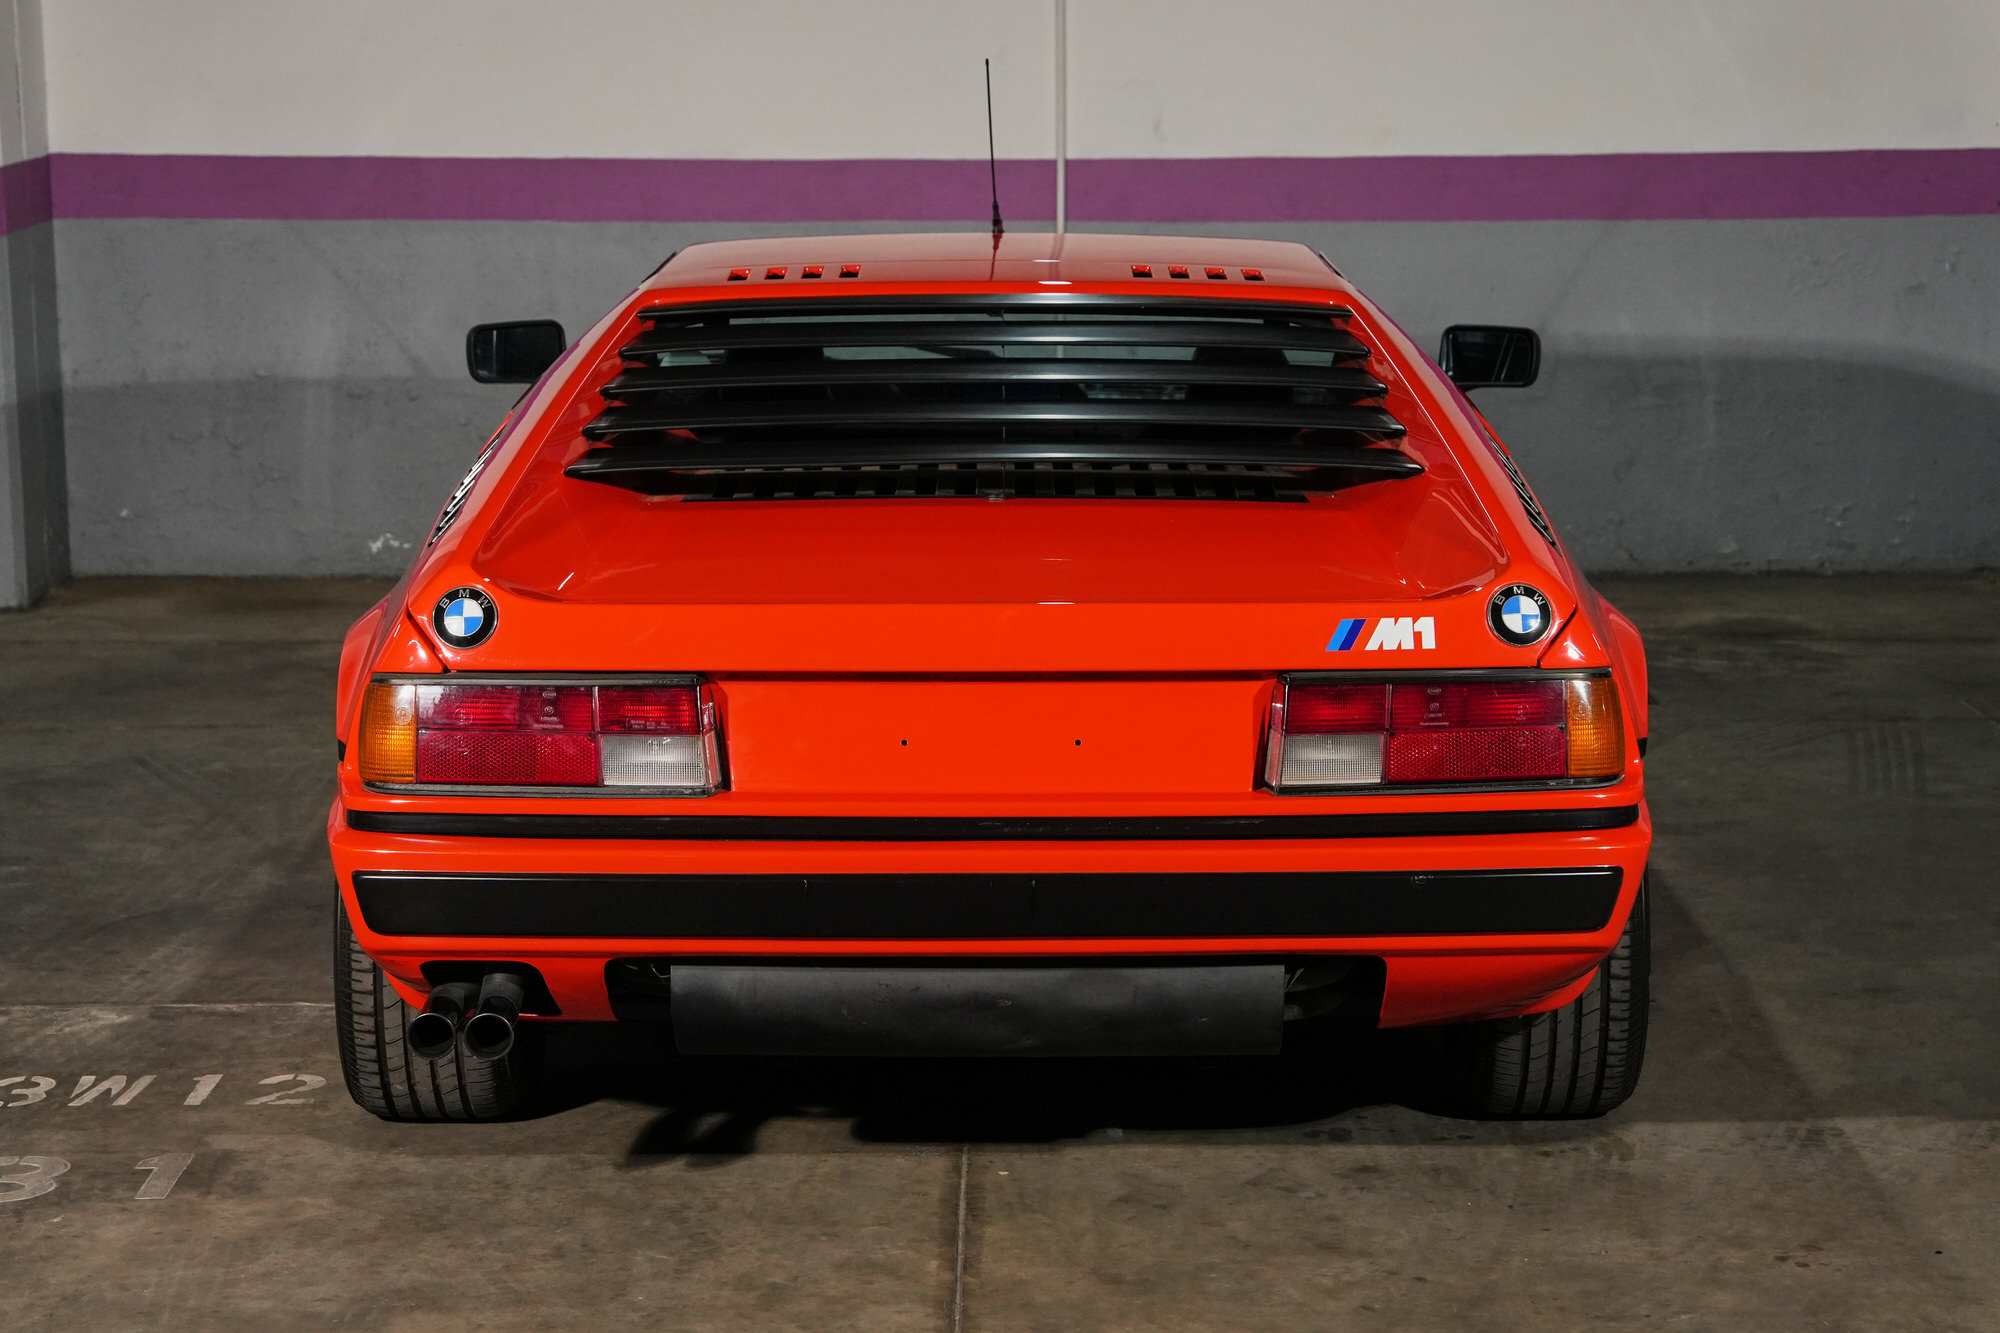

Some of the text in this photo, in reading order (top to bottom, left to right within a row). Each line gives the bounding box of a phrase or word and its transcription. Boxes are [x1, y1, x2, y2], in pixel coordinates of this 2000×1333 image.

[439, 588, 491, 608] BMW
[1494, 586, 1545, 606] BMW
[1365, 616, 1436, 651] M1
